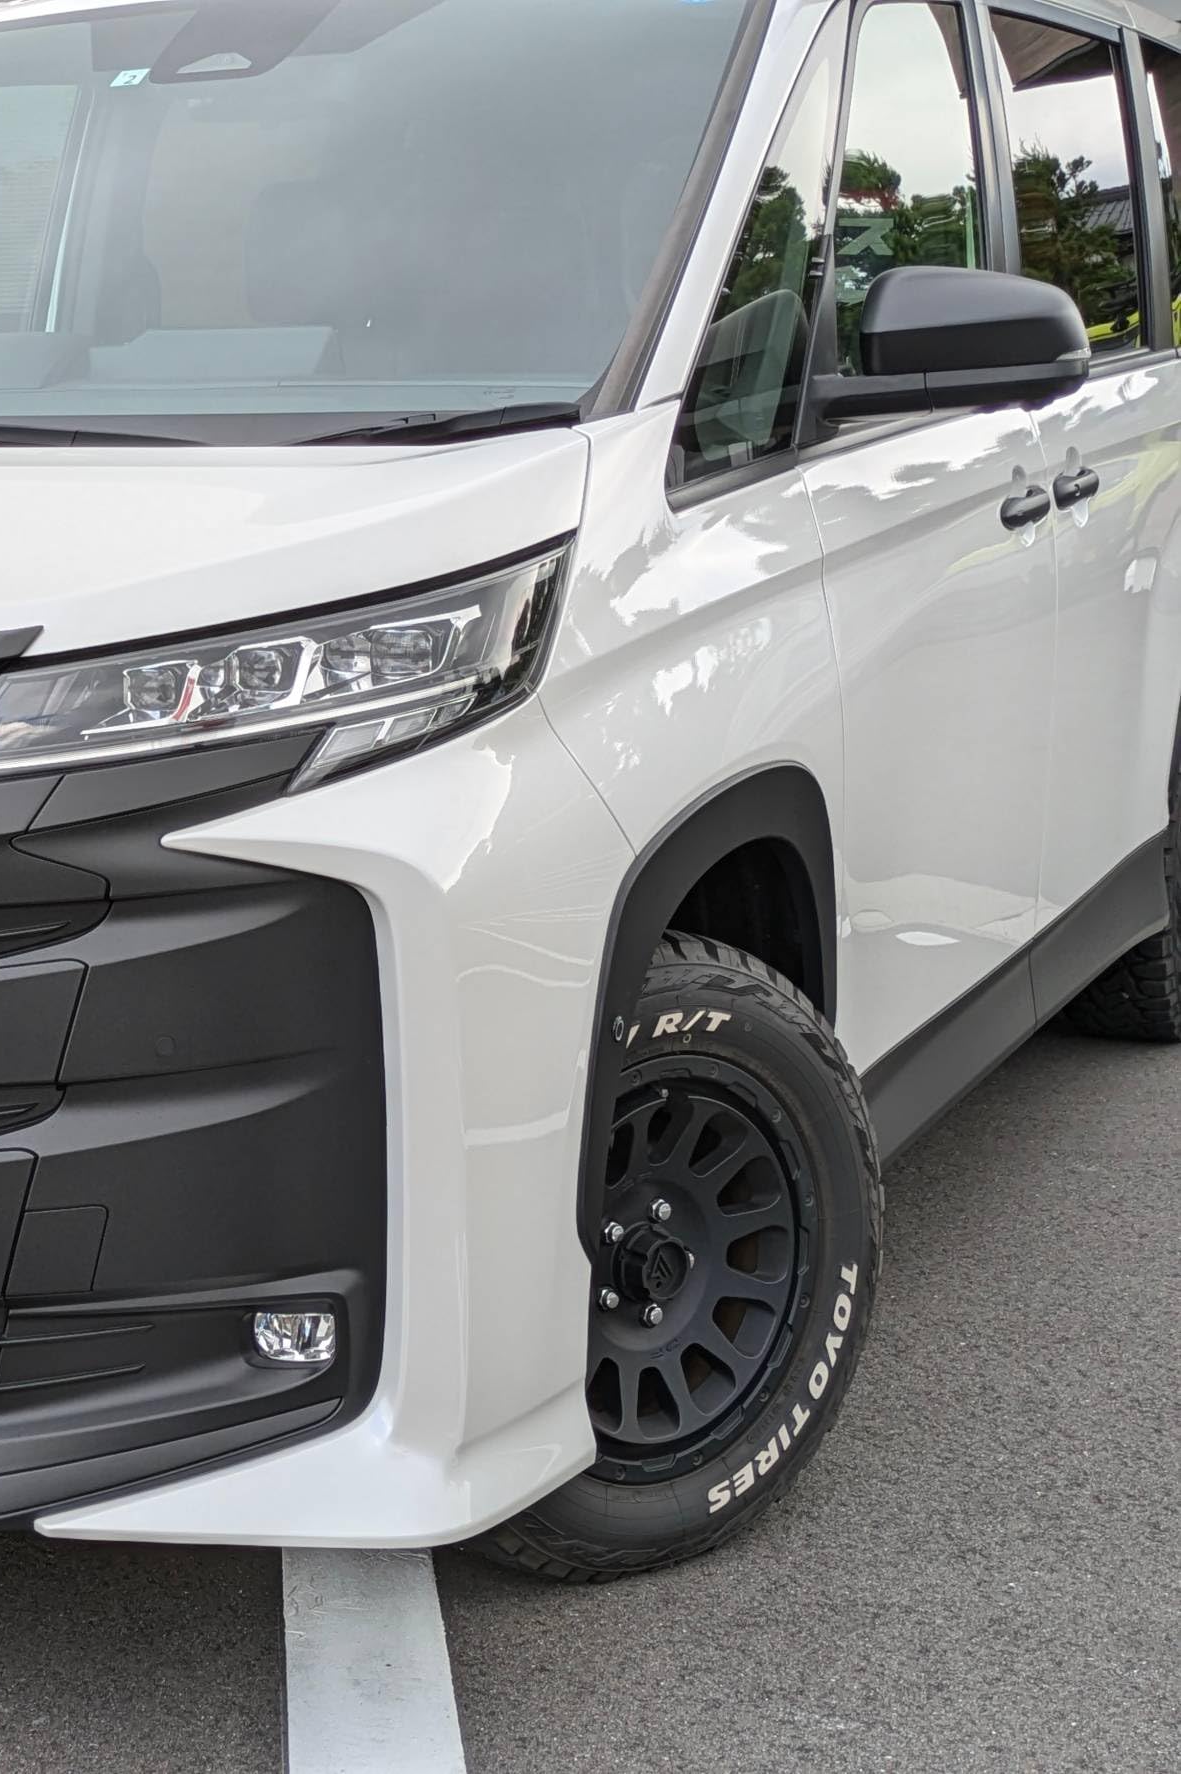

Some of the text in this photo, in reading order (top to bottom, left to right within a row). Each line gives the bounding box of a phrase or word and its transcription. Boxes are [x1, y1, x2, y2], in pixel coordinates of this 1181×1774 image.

[652, 1009, 732, 1038] R/T
[809, 1263, 858, 1400] TOYO
[708, 1403, 811, 1513] TIRES
